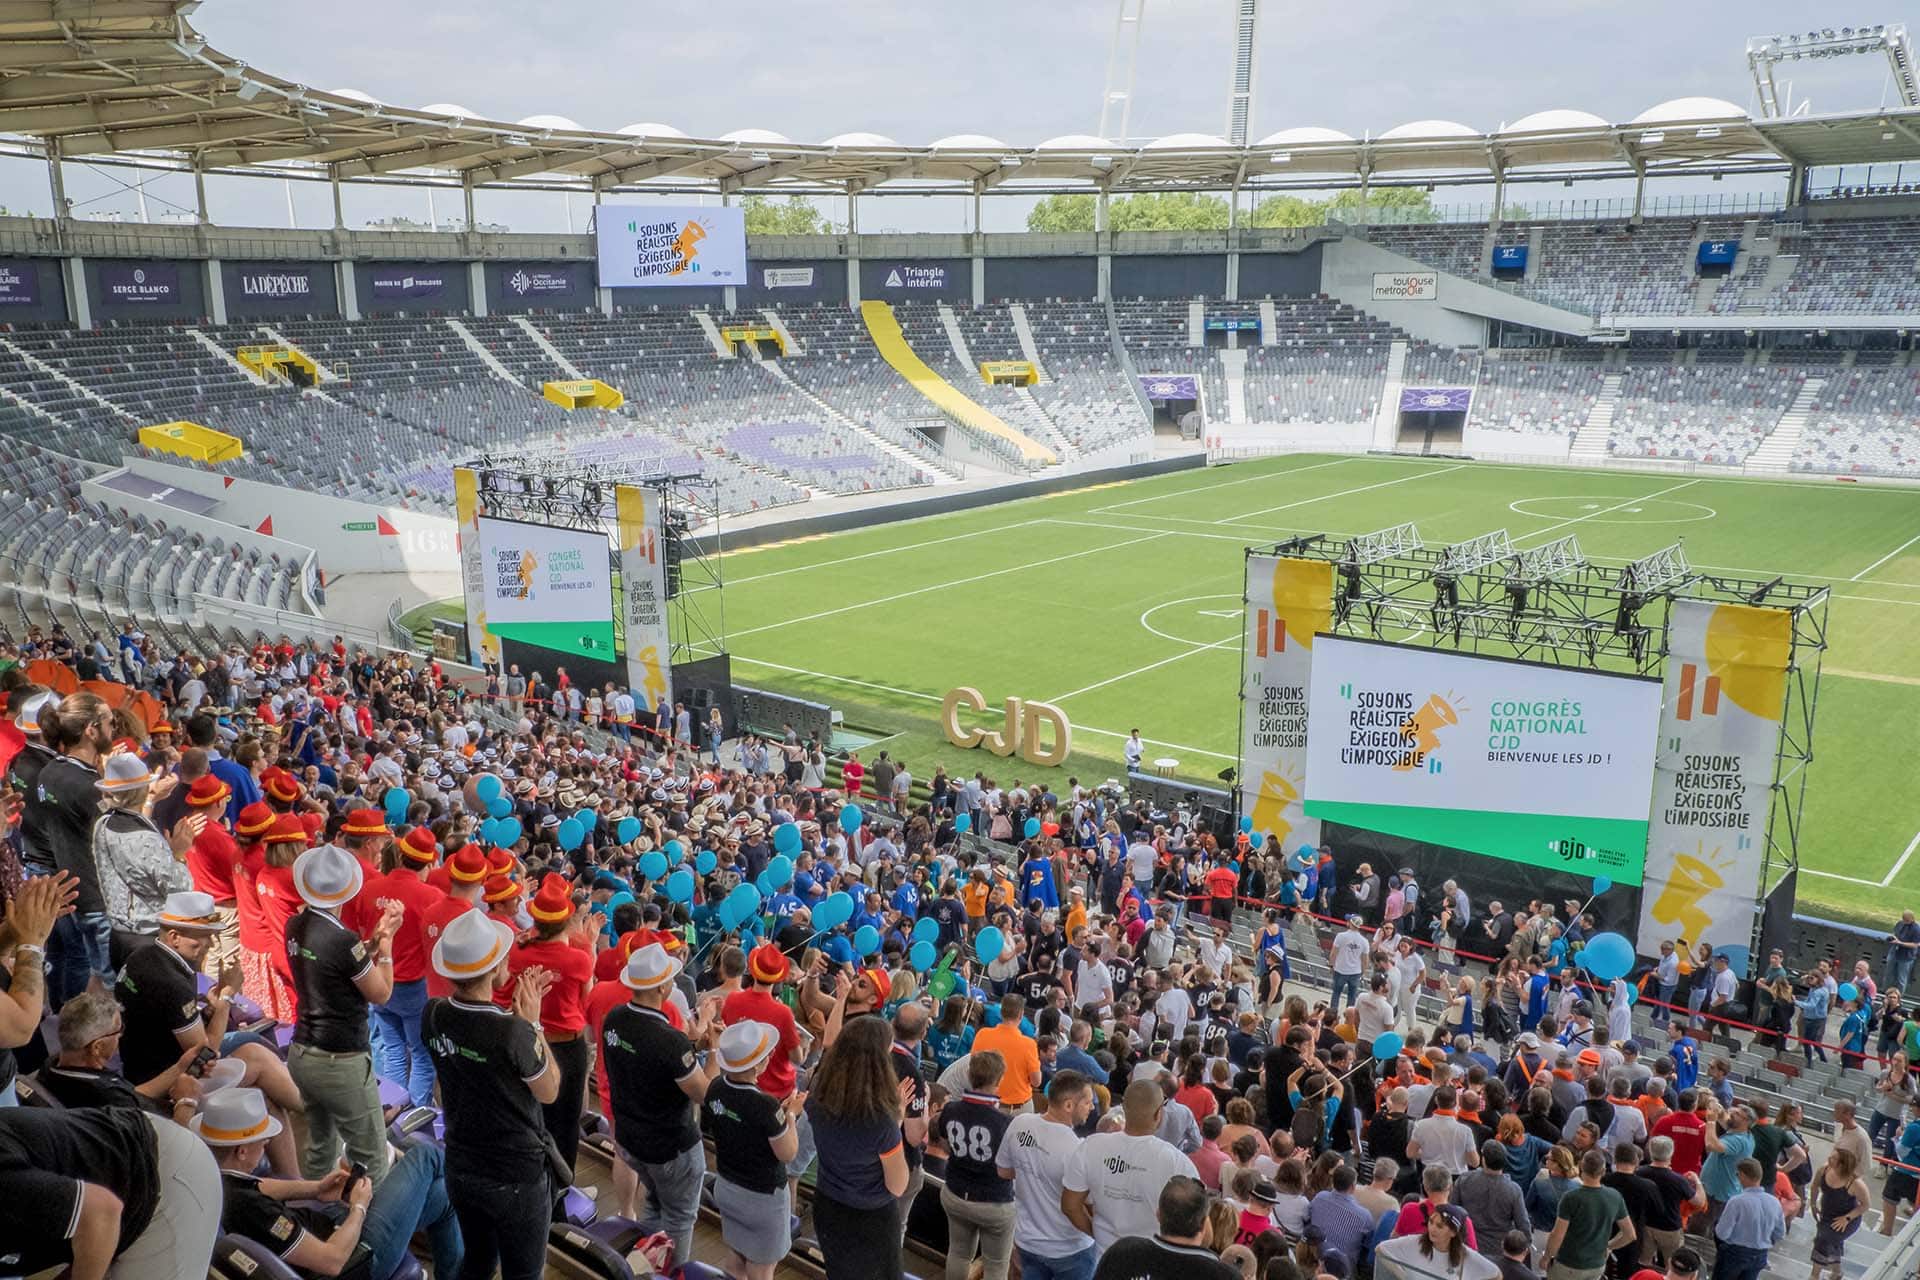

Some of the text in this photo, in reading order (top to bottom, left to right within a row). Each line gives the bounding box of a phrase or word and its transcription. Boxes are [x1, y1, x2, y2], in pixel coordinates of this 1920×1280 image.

[640, 222, 677, 237] SOYONS
[904, 267, 944, 279] Triangle
[112, 285, 169, 293] SERGE BLANCO
[243, 276, 259, 294] LA
[1264, 687, 1304, 700] SOYONS
[1357, 692, 1413, 709] SOYONS
[1491, 699, 1582, 717] CONGRÈS
[942, 687, 1072, 767] CJD
[1259, 716, 1307, 732] EXIGEONS
[1490, 719, 1588, 734] NATIONAL
[1350, 729, 1416, 748] EXIGEONS
[1488, 735, 1521, 750] CJD
[1341, 748, 1424, 767] L'IMPOSSIBLE
[1487, 751, 1559, 763] BIENVENUE
[1562, 753, 1583, 764] LES
[1587, 754, 1602, 764] JD
[1684, 755, 1741, 772] SOYONS
[1674, 791, 1742, 810] EXIGEONS
[1664, 808, 1750, 829] L'IMPOSSIBLE
[946, 1120, 992, 1162] 88
